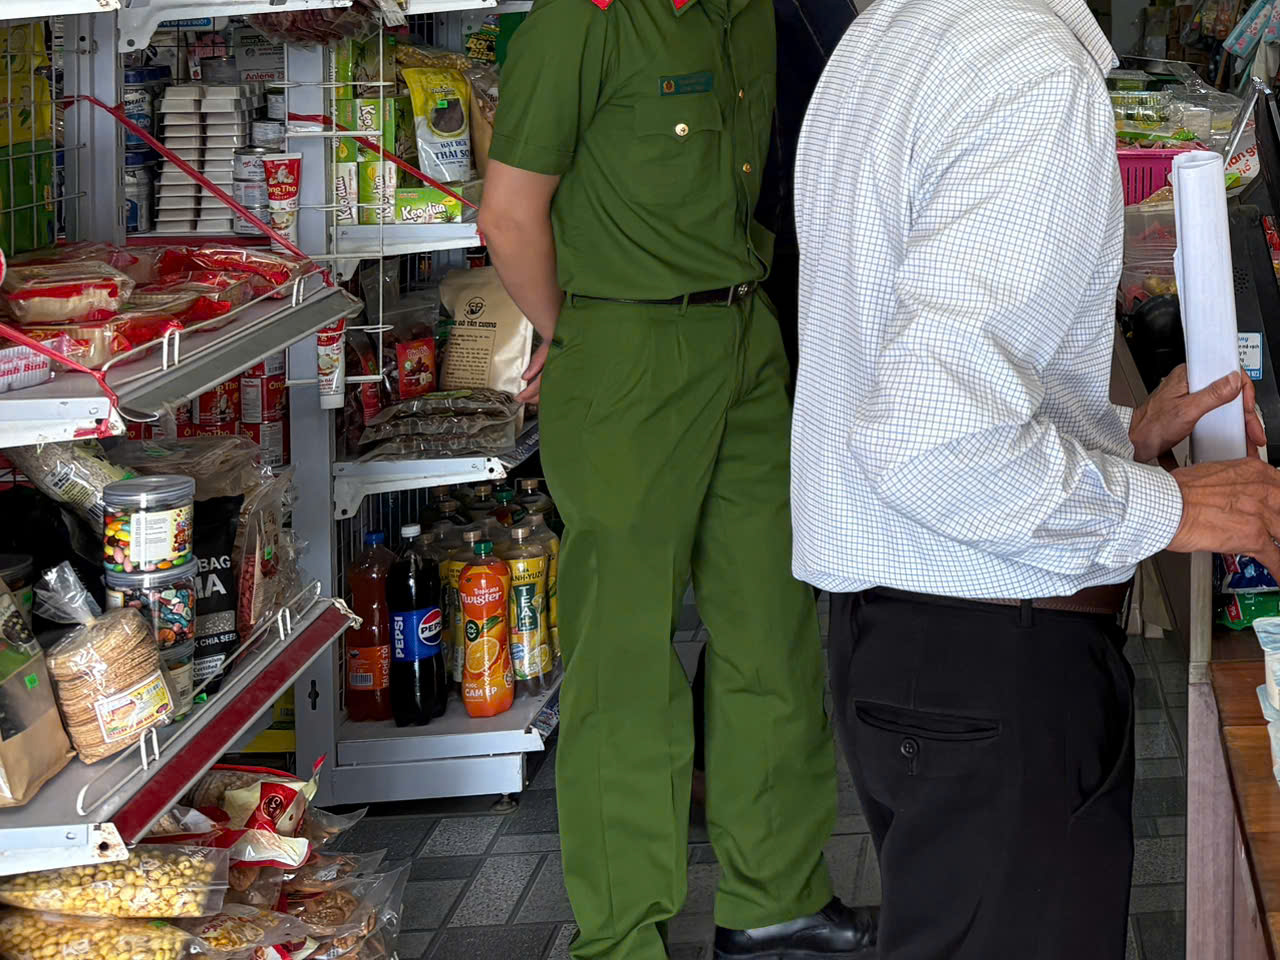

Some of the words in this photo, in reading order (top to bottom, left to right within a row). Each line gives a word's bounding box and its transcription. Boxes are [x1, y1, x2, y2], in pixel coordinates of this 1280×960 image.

[246, 72, 275, 80] Anlene
[360, 105, 377, 128] Kẹo
[401, 205, 424, 222] Kẹo
[425, 202, 446, 215] dừa
[461, 591, 503, 606] Twister
[394, 616, 406, 659] PEPSI
[465, 689, 484, 698] CAM
